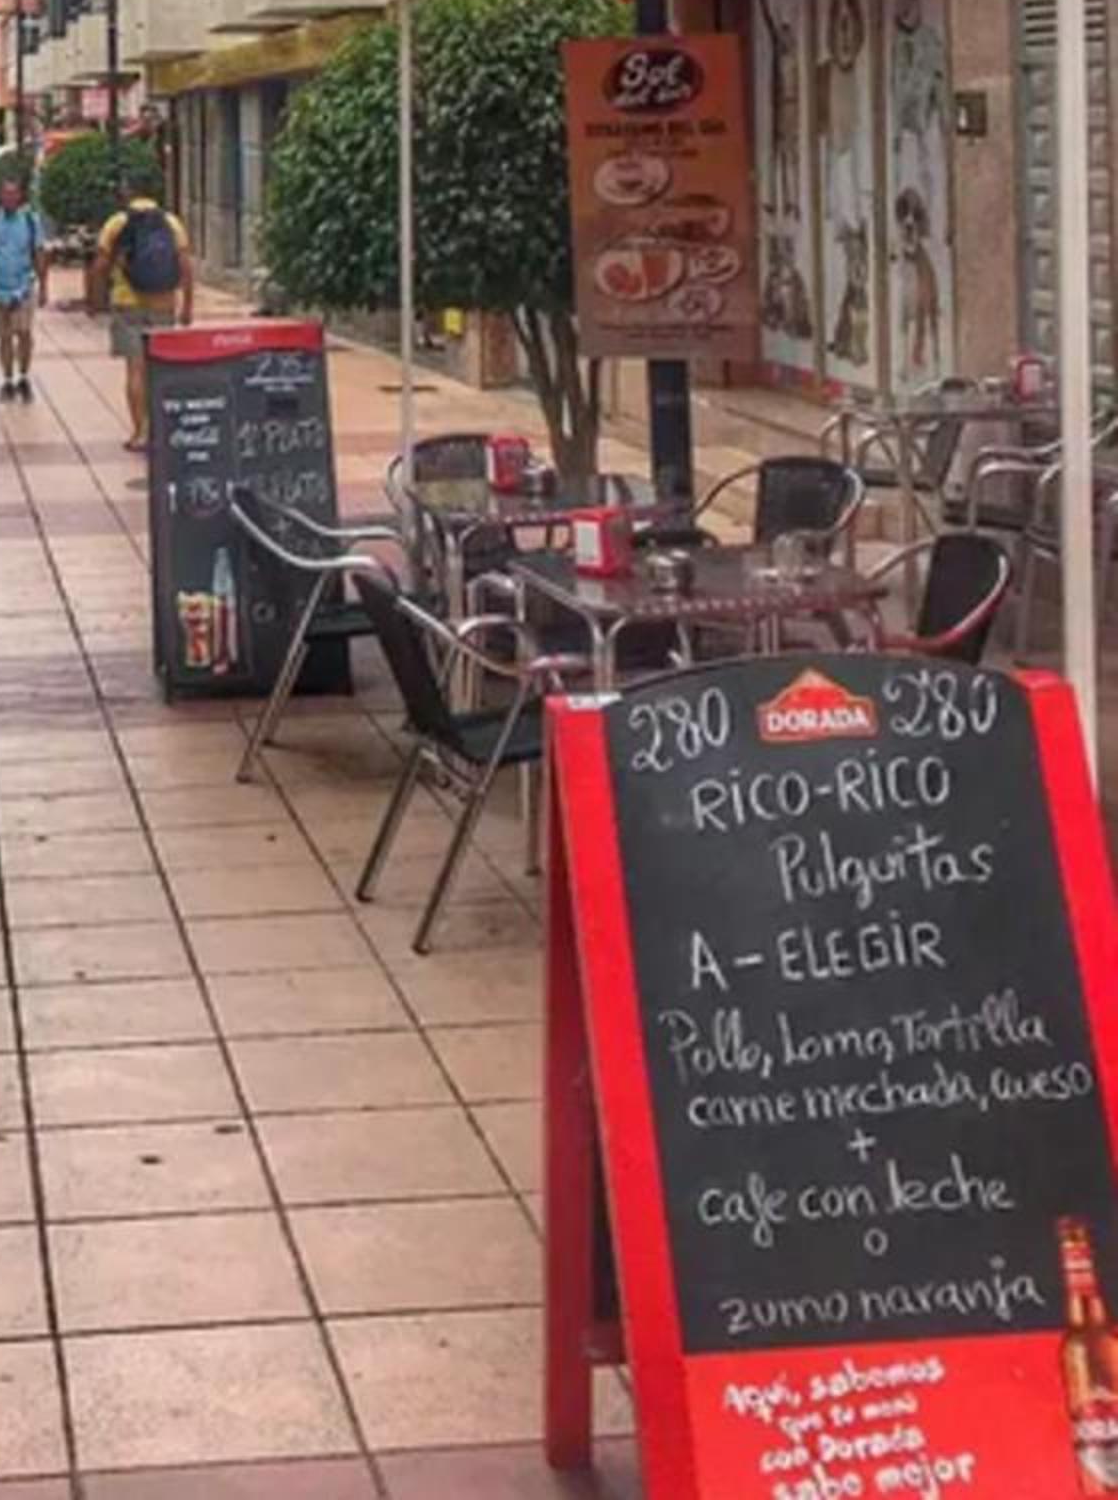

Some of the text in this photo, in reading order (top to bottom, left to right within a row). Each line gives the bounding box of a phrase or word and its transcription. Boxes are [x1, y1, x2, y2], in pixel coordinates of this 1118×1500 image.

[629, 687, 730, 772] 280
[766, 706, 869, 733] DORADA
[884, 670, 997, 740] 280
[770, 825, 994, 909] Pulguitas
[687, 1093, 796, 1127] carne
[798, 1185, 877, 1217] con
[884, 1153, 1016, 1214] leche
[720, 1255, 1047, 1335] zumo naranja
